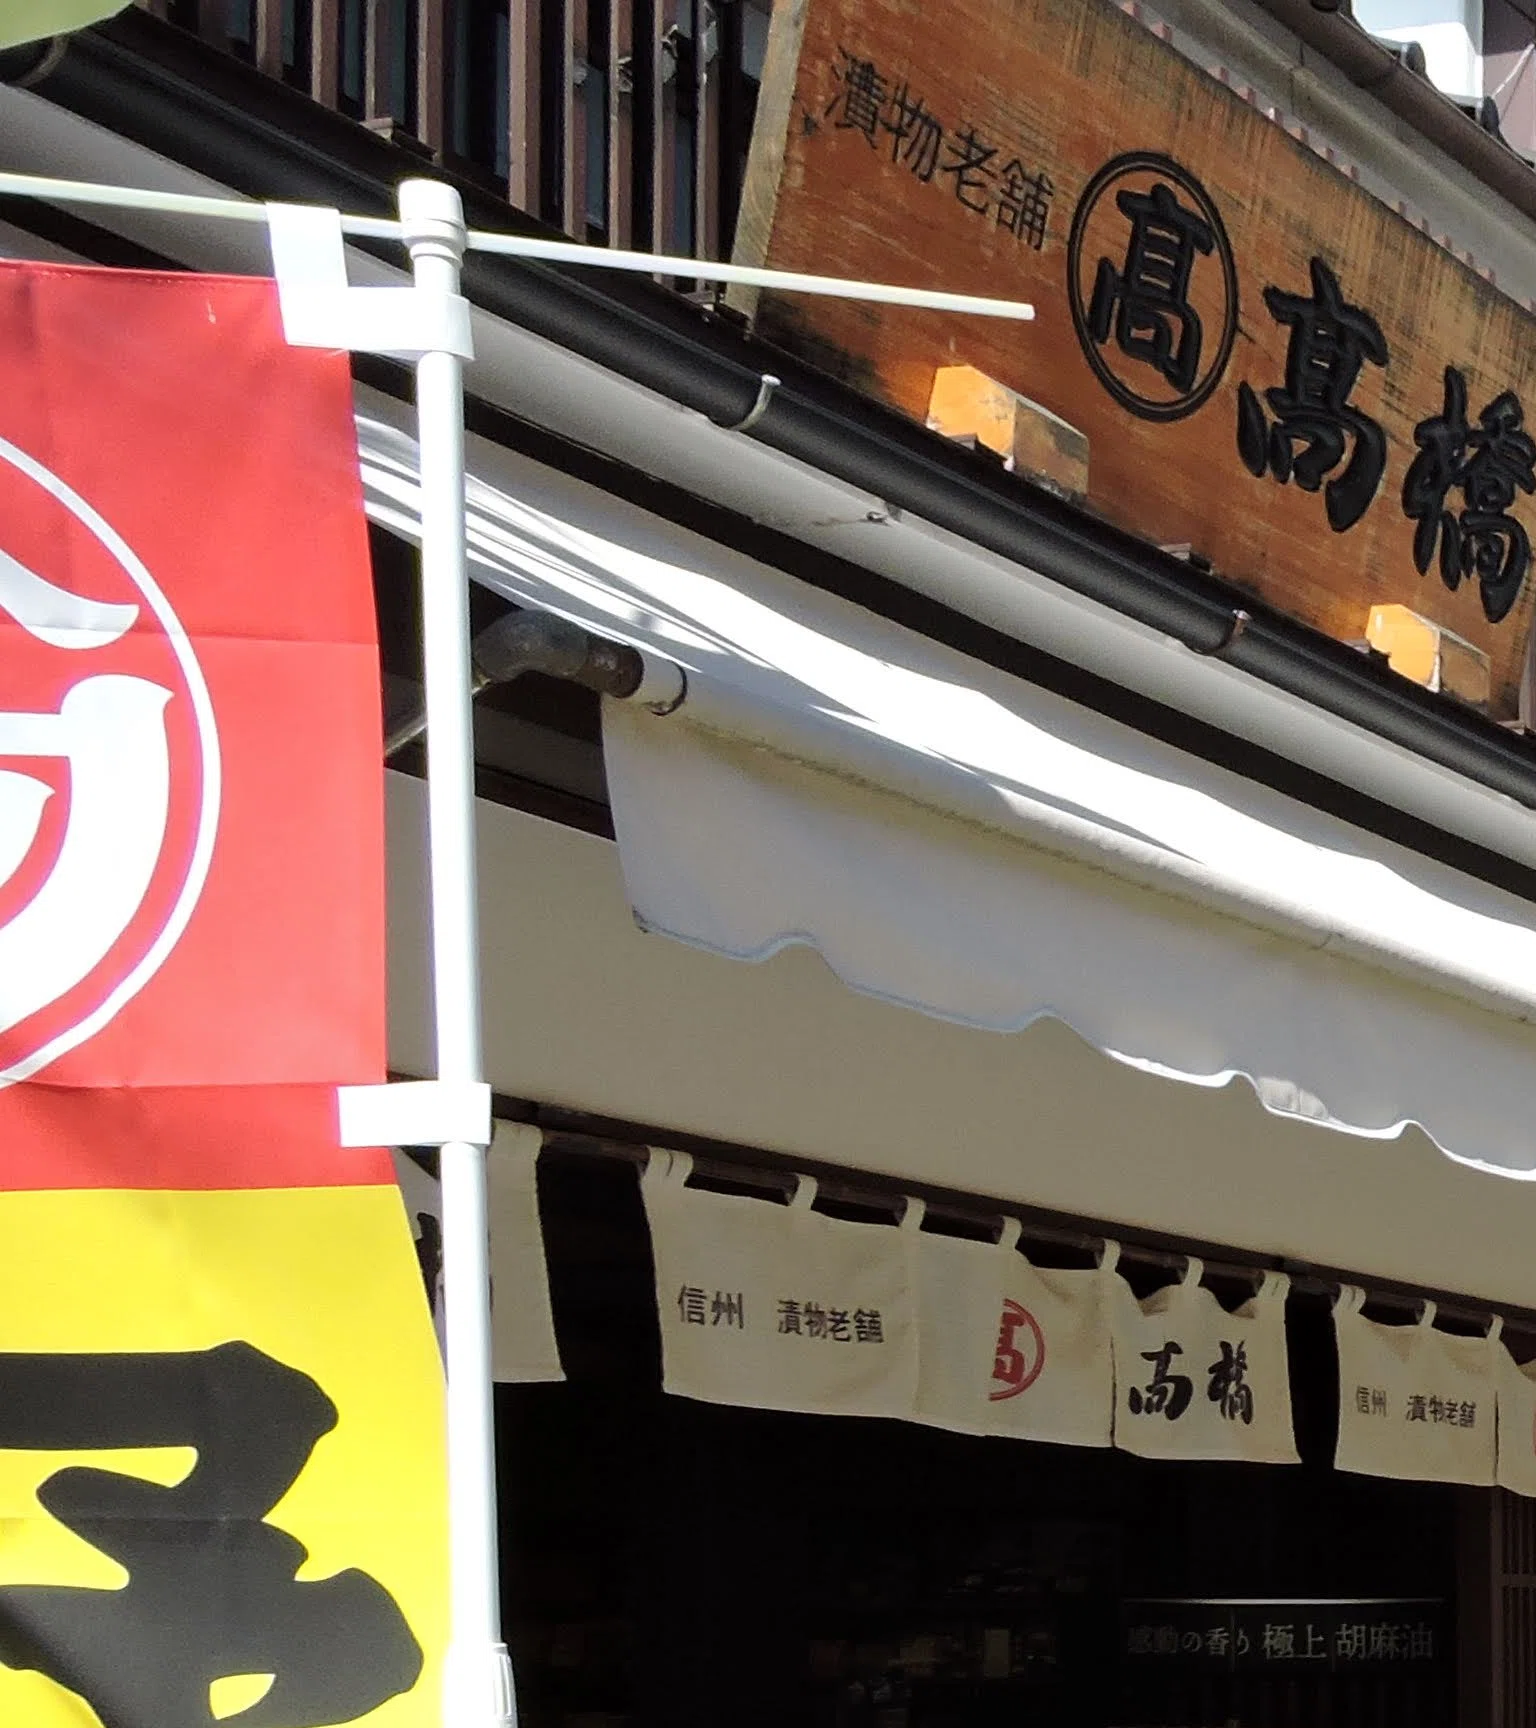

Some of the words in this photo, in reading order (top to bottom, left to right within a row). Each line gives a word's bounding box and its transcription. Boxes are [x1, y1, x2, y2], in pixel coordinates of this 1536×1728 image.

[675, 1284, 744, 1330] 信州
[1353, 1384, 1387, 1420] 信州
[1261, 1622, 1328, 1661] 極上
[1334, 1621, 1434, 1662] 胡麻油
